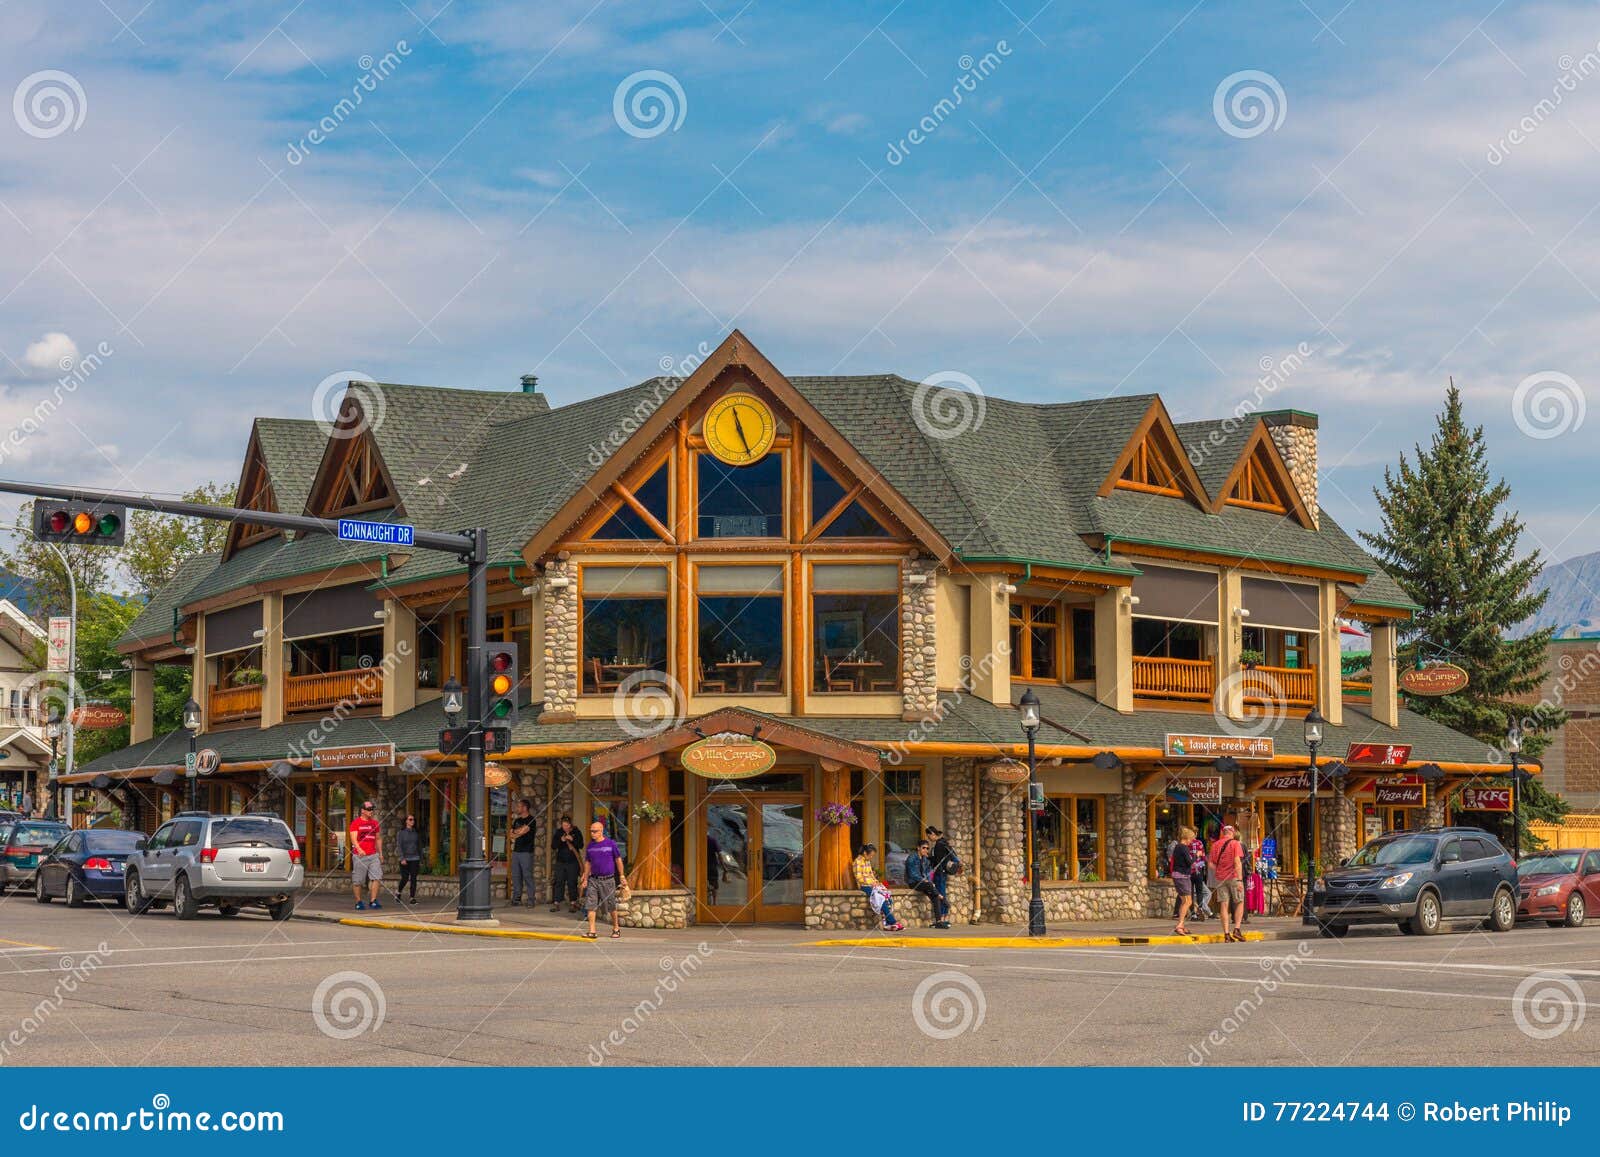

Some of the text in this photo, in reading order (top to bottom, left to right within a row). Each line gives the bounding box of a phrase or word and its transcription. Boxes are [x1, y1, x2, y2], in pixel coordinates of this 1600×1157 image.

[342, 522, 410, 543] CONNAUGHT DR
[1190, 736, 1269, 758] tangle creek gifts
[691, 749, 766, 761] Villa Caruso
[1391, 749, 1406, 758] KFC
[1188, 779, 1217, 791] tangle
[1266, 775, 1296, 789] Pizza
[1192, 789, 1219, 799] creek
[1376, 789, 1422, 801] Pizza Hut
[1478, 791, 1509, 801] KFC
